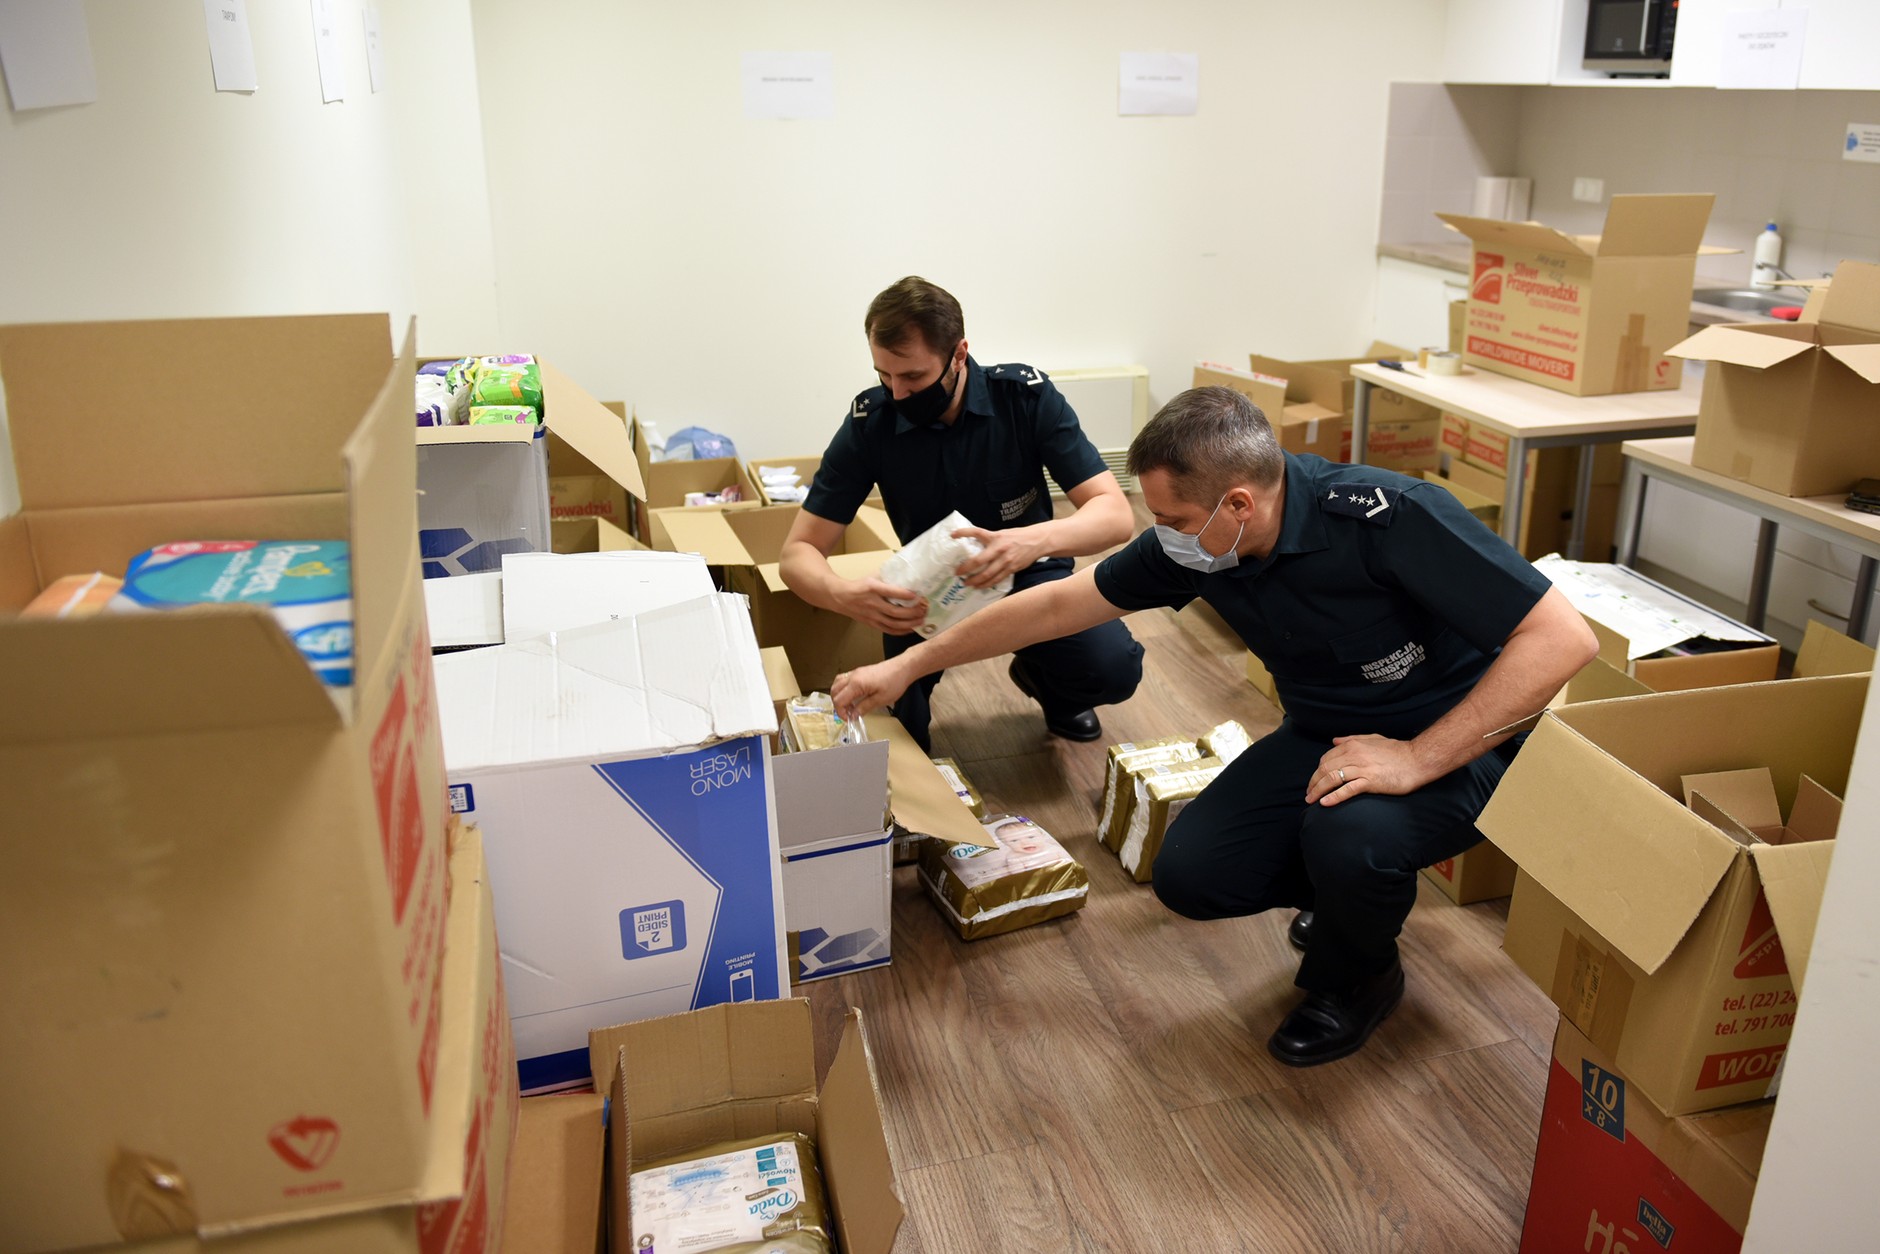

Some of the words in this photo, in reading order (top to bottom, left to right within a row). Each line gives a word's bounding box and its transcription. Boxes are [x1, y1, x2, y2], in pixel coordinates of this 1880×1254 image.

[1513, 262, 1540, 279] Silver
[1506, 273, 1579, 302] Przeprowadzki
[1471, 340, 1527, 365] WORLDWIDE
[1527, 354, 1570, 377] MOVERS
[1361, 641, 1416, 672] INSPEKCJA
[1362, 645, 1425, 680] TRANSPORTU
[690, 746, 750, 779] LASER
[691, 763, 751, 796] MONO
[953, 844, 981, 858] Da
[638, 911, 668, 924] PRINT
[638, 920, 668, 932] SIDED
[651, 931, 661, 943] 2
[725, 952, 756, 965] PRINTING
[728, 959, 753, 970] MOBILE
[1722, 995, 1746, 1011] tel.
[1749, 992, 1779, 1011] (22)
[1715, 1019, 1738, 1036] tel.
[1742, 1015, 1769, 1033] 791
[1770, 1012, 1796, 1029] 706
[1588, 1067, 1618, 1112] 10
[1583, 1101, 1593, 1117] x
[1596, 1112, 1606, 1129] 8
[748, 1191, 793, 1216] Dada
[1643, 1206, 1667, 1234] bella
